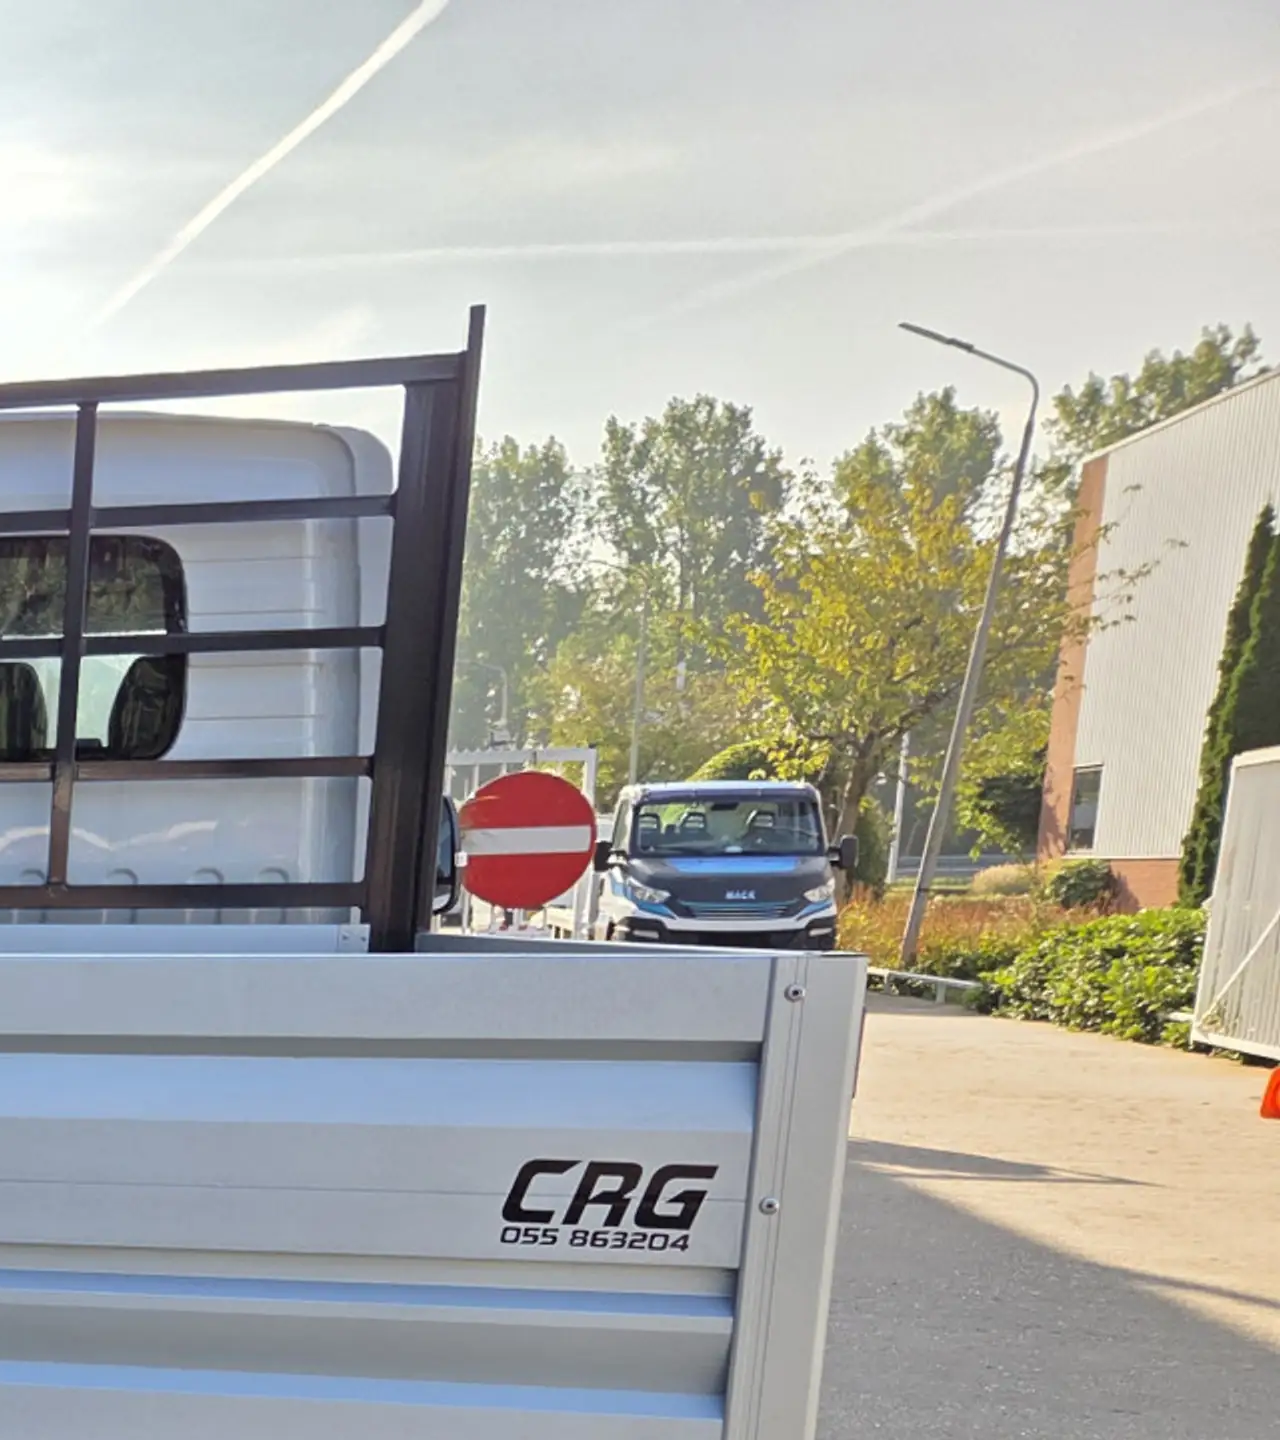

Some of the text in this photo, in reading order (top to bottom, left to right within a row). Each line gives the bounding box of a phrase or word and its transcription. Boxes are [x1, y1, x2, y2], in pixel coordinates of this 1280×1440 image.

[502, 1158, 719, 1231] CRG
[500, 1226, 691, 1252] 055 863204
